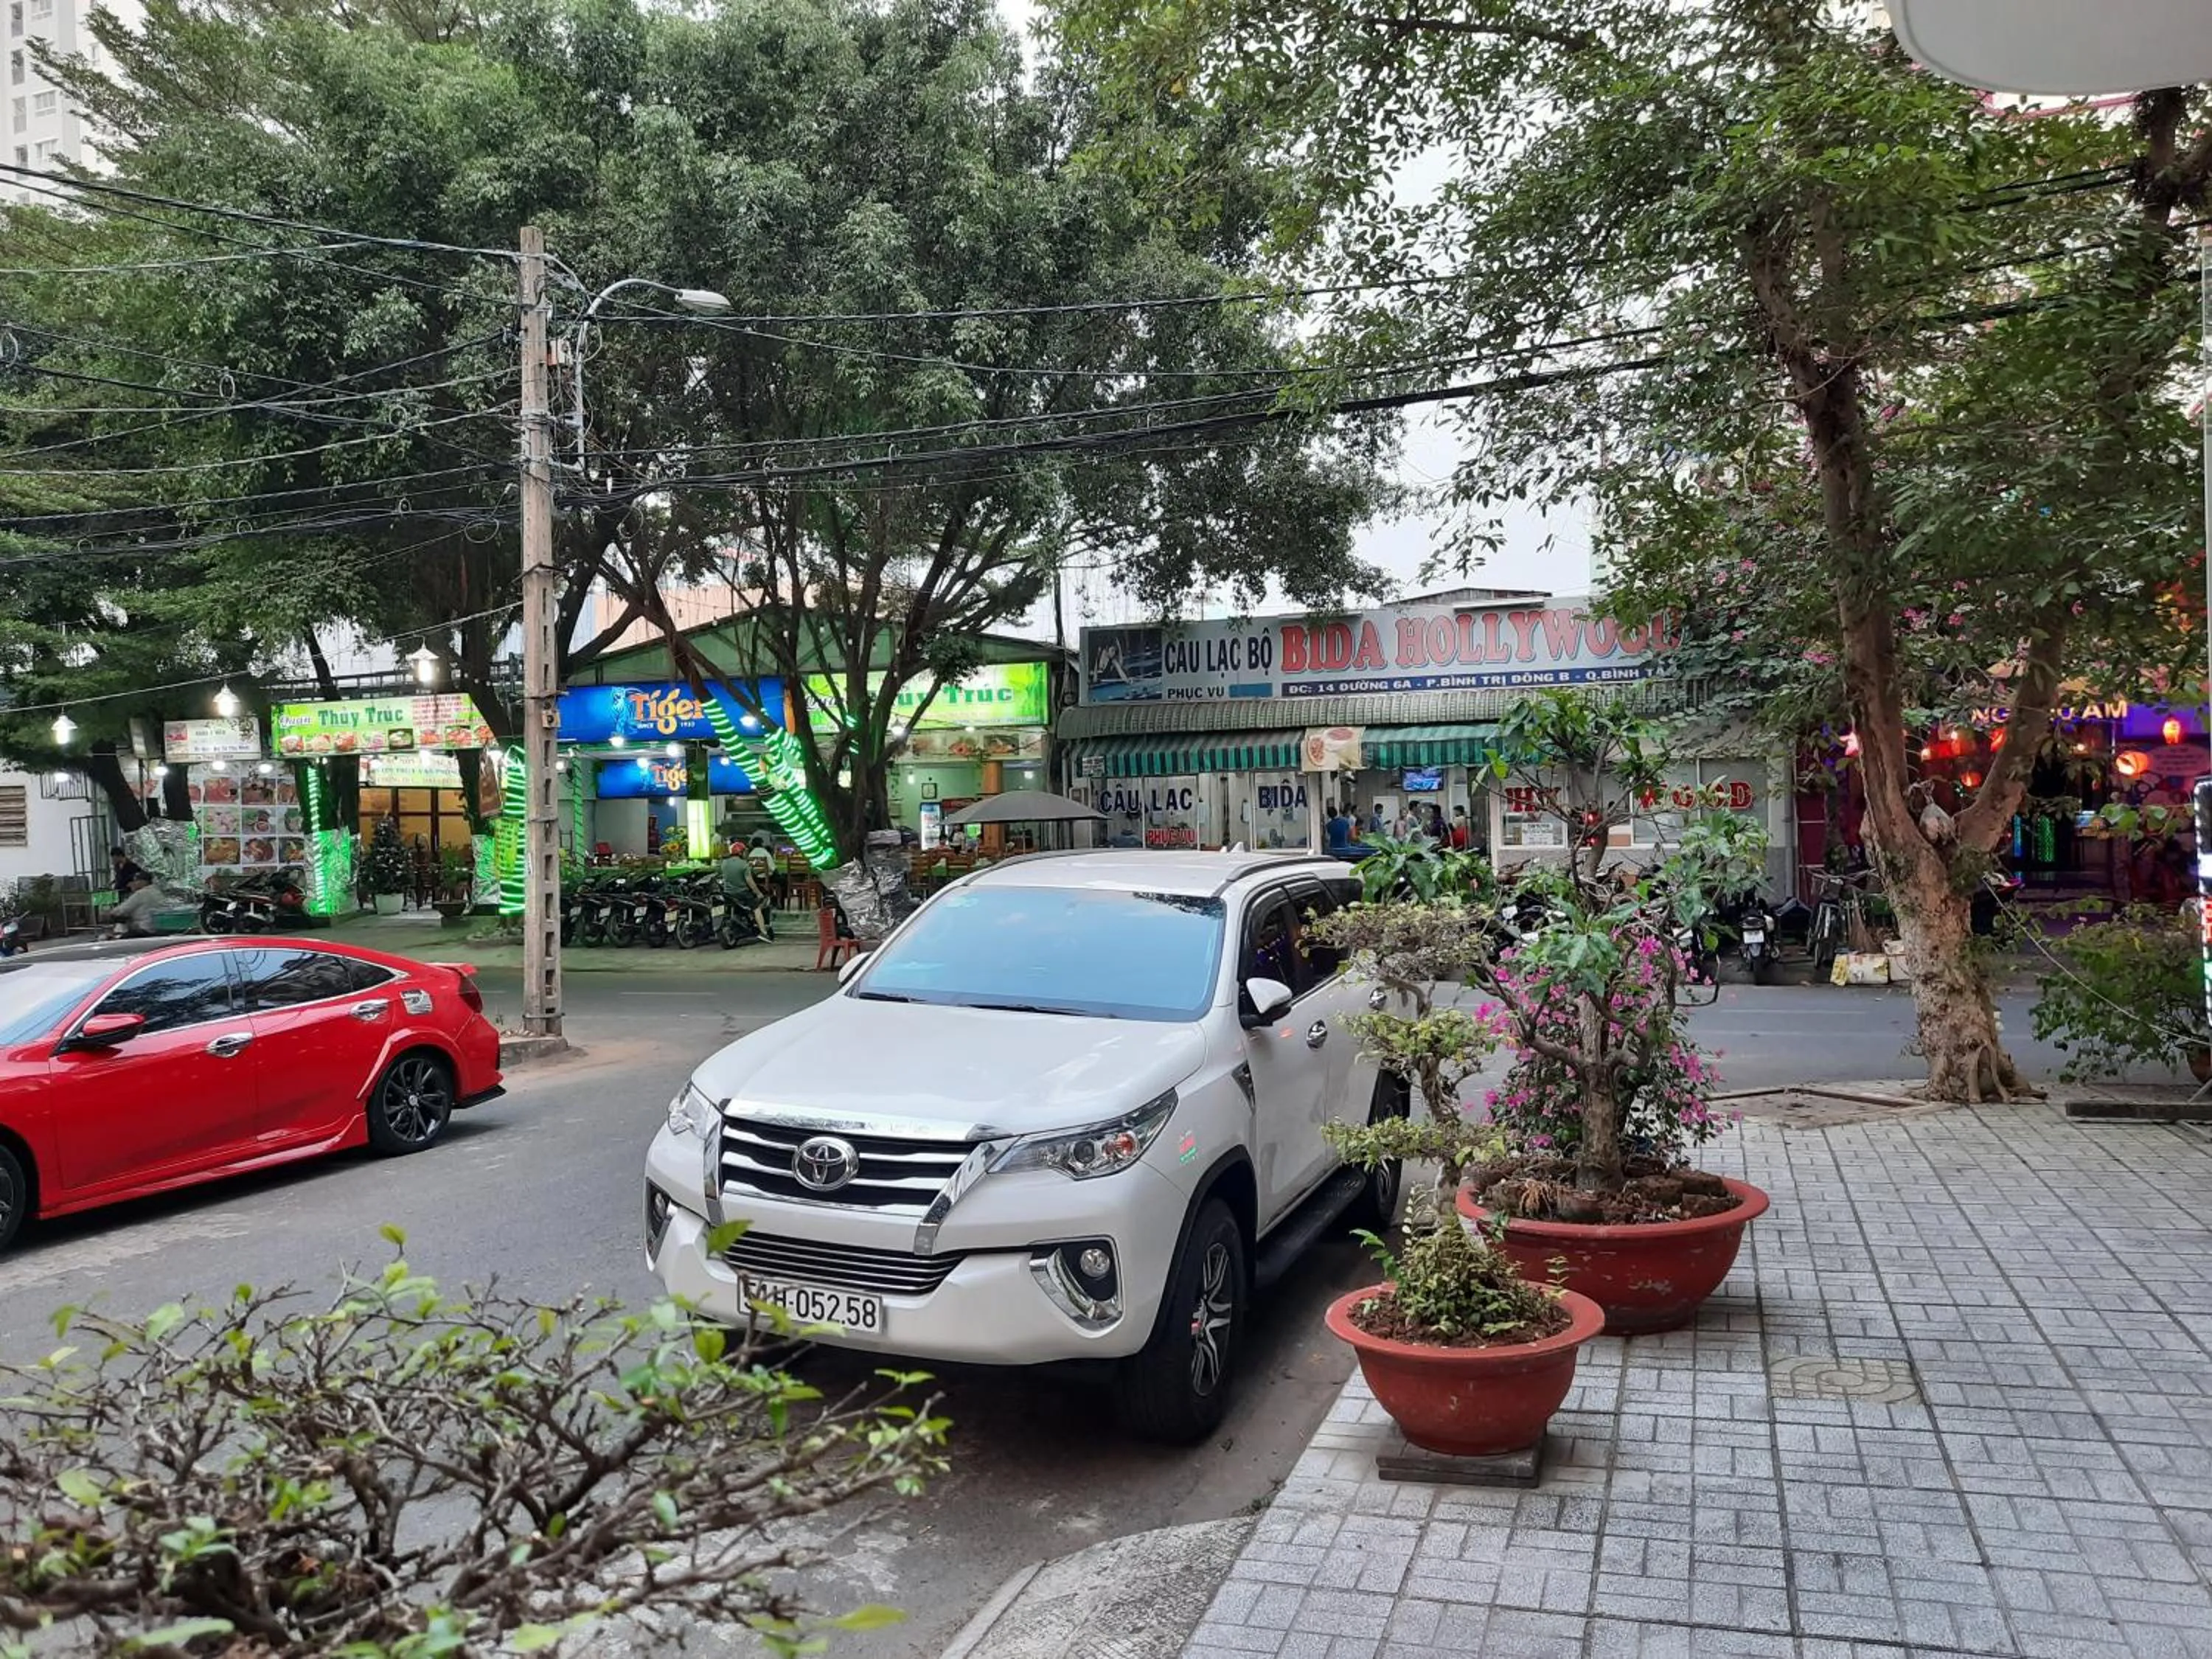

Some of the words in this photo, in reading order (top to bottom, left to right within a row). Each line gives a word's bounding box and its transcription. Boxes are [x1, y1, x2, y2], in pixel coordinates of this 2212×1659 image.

[1207, 639, 1242, 678] LẠC
[1248, 627, 1273, 675] BỘ
[1281, 620, 1387, 673] BIDA
[943, 683, 1013, 704] Trúc
[1167, 686, 1203, 700] PHỤC
[1318, 684, 1335, 692] 14
[1340, 679, 1388, 691] ĐƯỜNG
[1427, 675, 1476, 686] P.BÌNH
[1482, 675, 1506, 686] TRỊ
[1512, 671, 1554, 683] ĐÔNG
[1559, 672, 1570, 682] B
[1586, 667, 1639, 681] Q.BÌNH
[364, 705, 404, 723] Trúc
[630, 689, 705, 734] Tiger
[651, 759, 687, 791] Tige
[1099, 783, 1140, 813] CÂU
